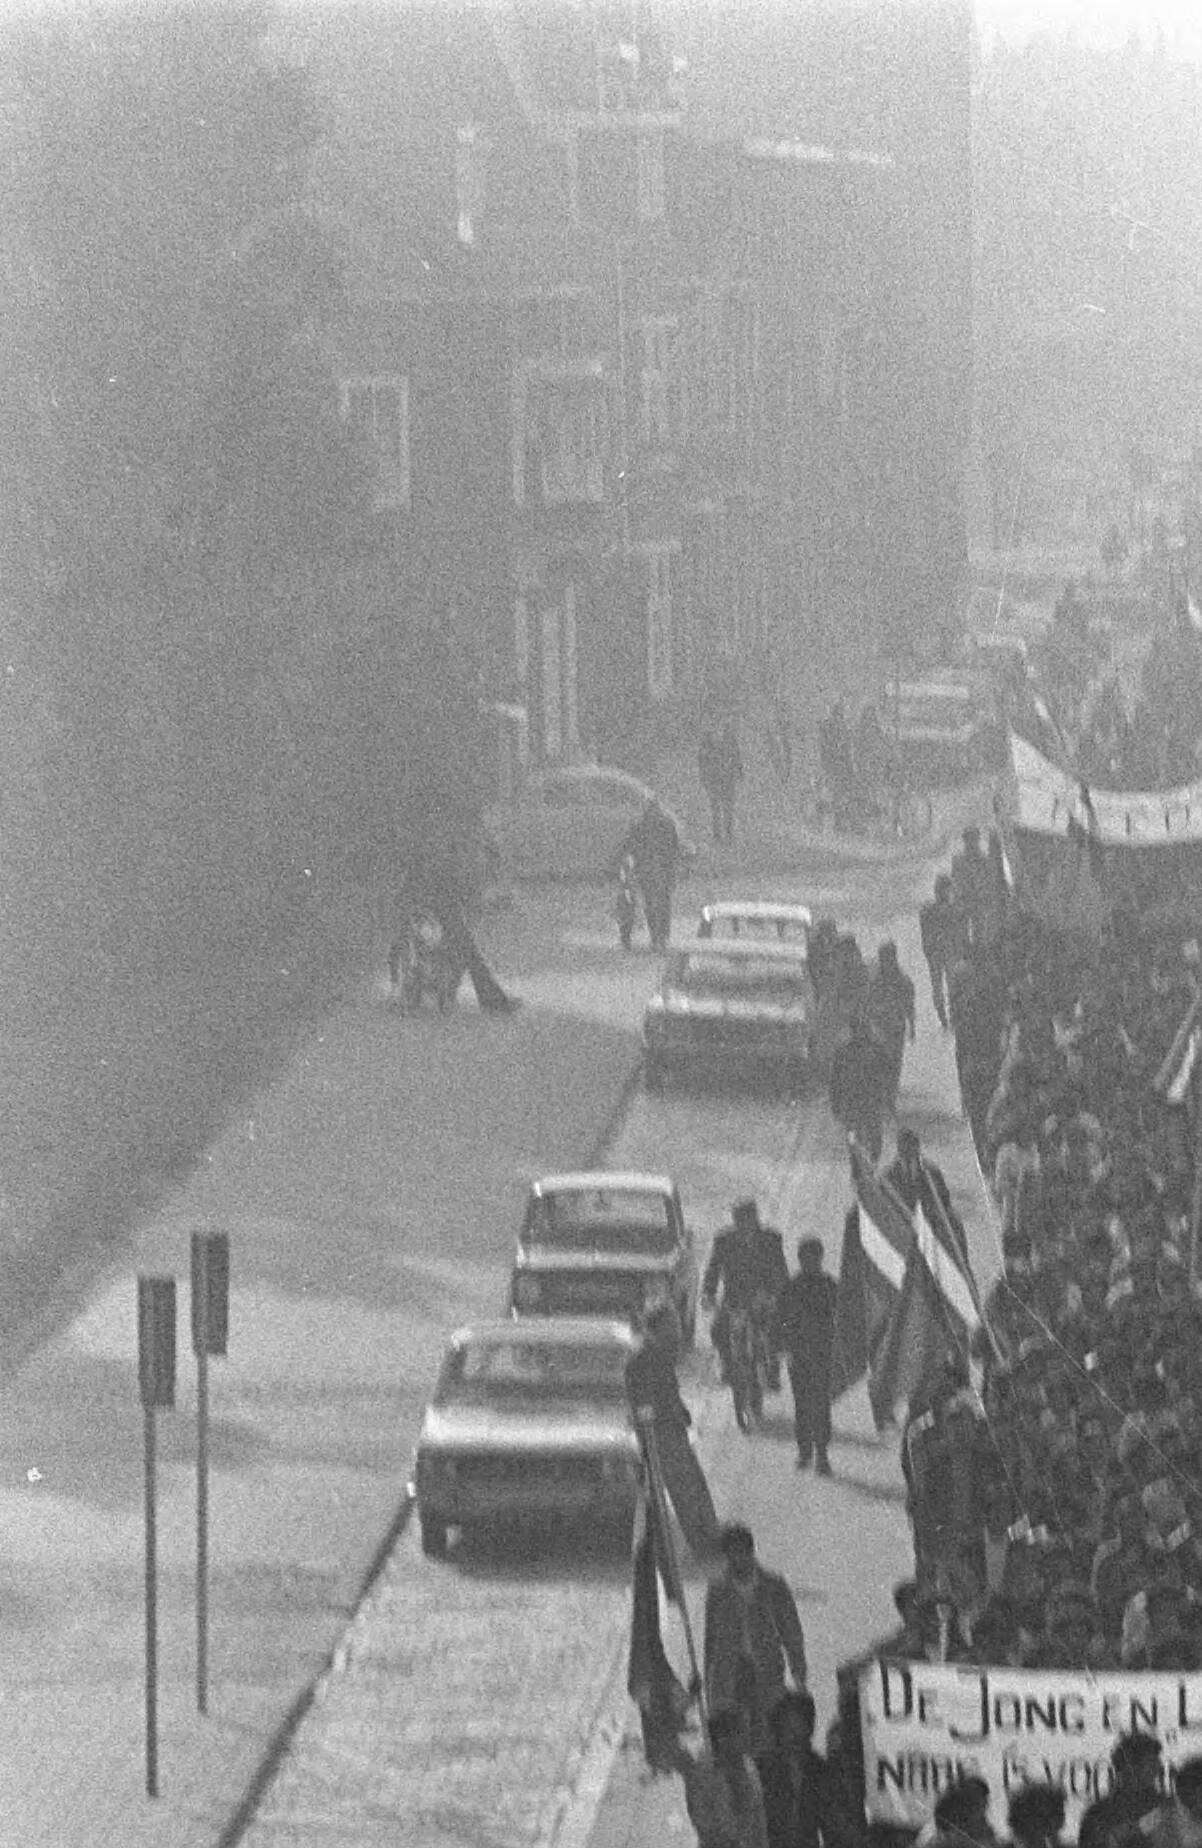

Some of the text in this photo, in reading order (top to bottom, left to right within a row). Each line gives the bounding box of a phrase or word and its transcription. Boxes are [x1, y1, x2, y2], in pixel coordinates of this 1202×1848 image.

[879, 1658, 943, 1726] DE
[949, 1666, 1085, 1743] JONG
[1102, 1691, 1157, 1731] EN
